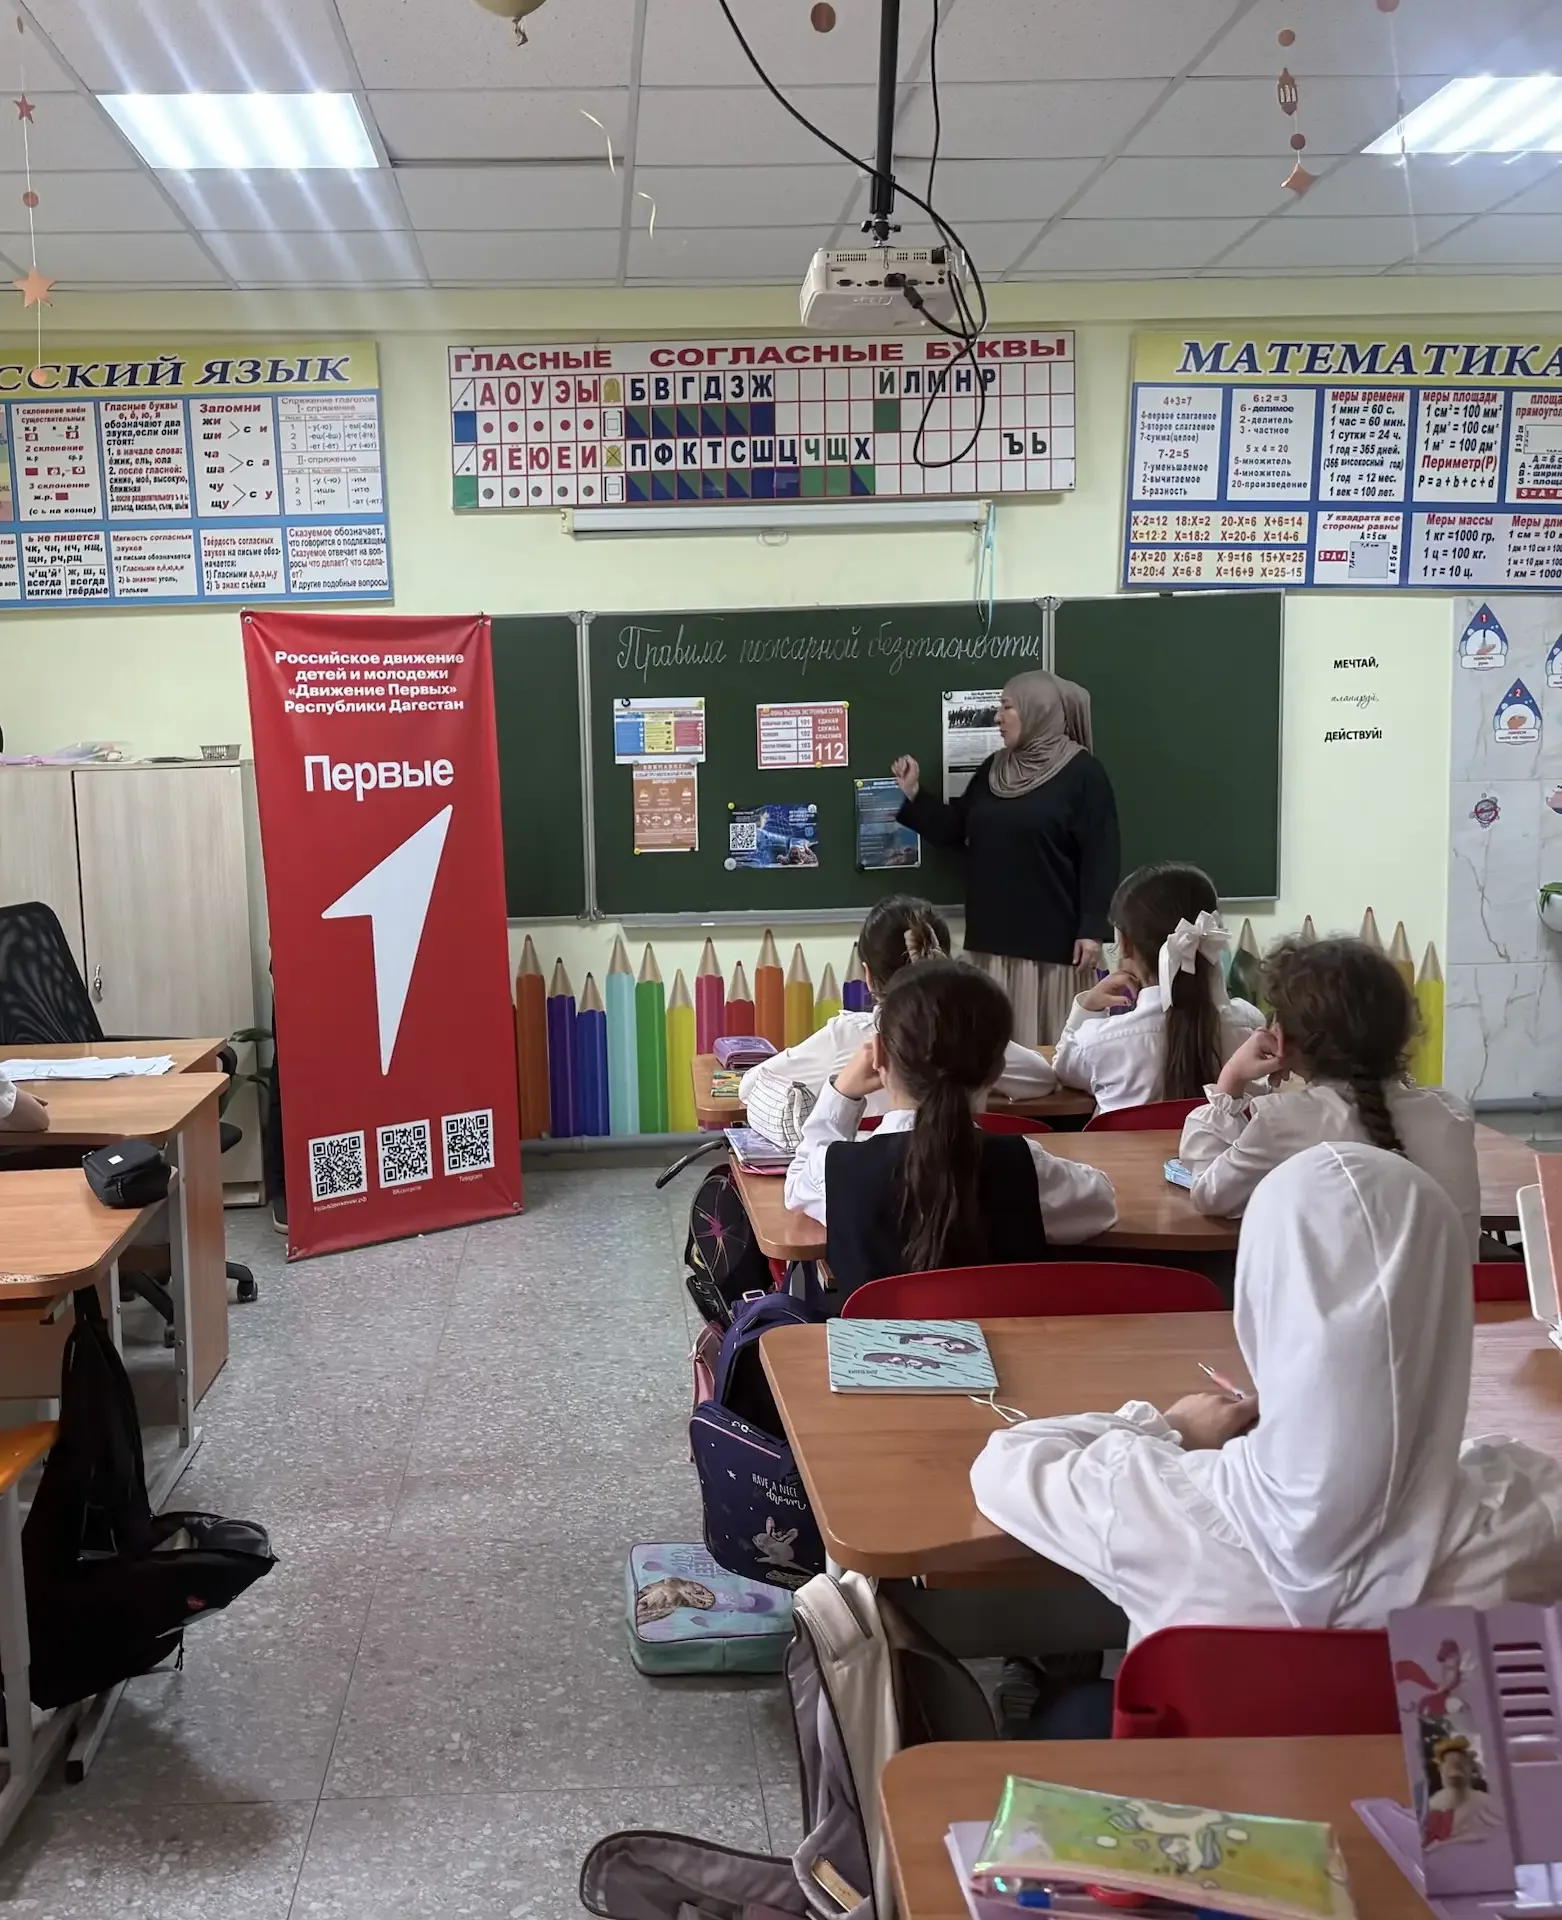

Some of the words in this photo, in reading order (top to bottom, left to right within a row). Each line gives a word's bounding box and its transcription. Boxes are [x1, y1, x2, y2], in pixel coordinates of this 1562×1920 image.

[649, 343, 904, 367] СОГЛАСНЫЕ
[926, 339, 1065, 360] БУКВЫ
[454, 350, 612, 373] ГЛАСНЫЕ
[194, 357, 350, 385] ЯЗЫК
[879, 367, 895, 394] Й
[904, 370, 920, 393] Л
[956, 369, 971, 392] Н
[479, 382, 497, 406] А
[505, 381, 521, 405] О
[531, 381, 548, 405] У
[555, 380, 574, 404] Э
[578, 379, 598, 403] Ы
[631, 379, 646, 401] Б
[655, 378, 669, 400] В
[682, 377, 695, 400] Г
[704, 376, 722, 401] Д
[731, 375, 744, 398] З
[752, 374, 772, 397] Ж
[1331, 391, 1359, 404] меры
[1361, 391, 1405, 405] времени
[1422, 391, 1450, 404] меры
[1452, 391, 1498, 405] площади
[104, 401, 146, 412] Гласные
[149, 402, 178, 412] буквы
[200, 403, 261, 413] Запомни
[1339, 406, 1360, 414] мин
[1371, 404, 1383, 414] 60
[1463, 404, 1481, 418] 100
[1176, 412, 1217, 421] слагаемое
[1339, 418, 1357, 426] час
[1368, 416, 1380, 427] 60
[1383, 419, 1406, 427] мин.
[104, 420, 162, 429] обозначают
[164, 420, 181, 428] два
[1174, 423, 1215, 431] слагаемое
[1462, 421, 1479, 434] 100
[203, 432, 222, 440] ши
[1338, 431, 1366, 442] сутки
[1377, 429, 1390, 440] 24
[1003, 433, 1023, 455] Ъ
[1032, 432, 1047, 454] Ь
[1459, 438, 1477, 451] 100
[204, 450, 220, 458] ча
[631, 444, 646, 466] П
[654, 443, 673, 466] Ф
[683, 442, 697, 465] К
[707, 441, 722, 464] Т
[730, 440, 745, 463] С
[752, 440, 773, 462] Ш
[779, 439, 797, 465] Ц
[805, 438, 820, 461] Ч
[827, 438, 847, 462] Щ
[854, 437, 870, 460] Х
[1336, 446, 1350, 456] год
[1360, 444, 1375, 454] 365
[1377, 445, 1400, 455] дней.
[482, 448, 498, 471] Я
[508, 444, 522, 470] Ё
[529, 447, 549, 470] Ю
[557, 447, 571, 469] Е
[581, 445, 597, 468] И
[1341, 456, 1385, 467] високосный
[206, 465, 225, 474] ша
[1336, 474, 1351, 484] год
[1366, 473, 1376, 482] 12
[1378, 475, 1397, 483] мес.
[209, 482, 224, 492] чу
[1231, 480, 1308, 490] 20-произведение
[1336, 488, 1351, 496] век
[1361, 487, 1376, 497] 100
[1377, 489, 1395, 497] лет.
[210, 500, 230, 510] щу
[1426, 513, 1456, 528] Меры
[1458, 516, 1494, 526] массы
[1511, 515, 1541, 530] Меры
[54, 534, 100, 542] пишется
[150, 534, 192, 542] согласных
[289, 528, 332, 538] Сказуемое
[334, 527, 383, 536] обозначает,
[1433, 531, 1446, 541] кг
[1543, 530, 1556, 539] 10
[203, 536, 237, 547] Твёрдость
[238, 536, 274, 545] согласных
[301, 539, 336, 547] говорится
[343, 537, 386, 546] подлежащем
[238, 548, 262, 557] письме
[291, 549, 327, 559] Сказуемое
[328, 548, 358, 557] отвечает
[1452, 547, 1470, 559] 100
[290, 560, 308, 569] росы
[322, 558, 348, 568] делает?
[213, 570, 248, 579] Гласными
[1449, 565, 1460, 577] 10
[27, 579, 61, 587] всегда
[70, 578, 105, 587] всегда
[299, 580, 321, 590] другие
[323, 579, 357, 589] подобные
[358, 578, 387, 588] вопросы
[27, 587, 63, 596] мягкие
[68, 586, 109, 596] твёрдые
[274, 651, 381, 665] Российское
[383, 651, 465, 666] движение
[617, 624, 726, 683] Правила
[740, 626, 861, 675] пожарной
[1333, 656, 1379, 669] МЕЧТАЙ,
[295, 667, 347, 683] детей
[349, 669, 361, 680] и
[364, 669, 448, 682] молодежи
[288, 684, 385, 699] «Движение
[388, 683, 457, 698] Первых»
[284, 699, 386, 715] Республики
[389, 699, 464, 713] Дагестан
[1324, 727, 1383, 743] ДЕЙСТВУЙ!
[815, 742, 844, 760] 112
[303, 754, 455, 802] Первые
[752, 1472, 769, 1489] HAVE
[779, 1484, 798, 1497] NICE
